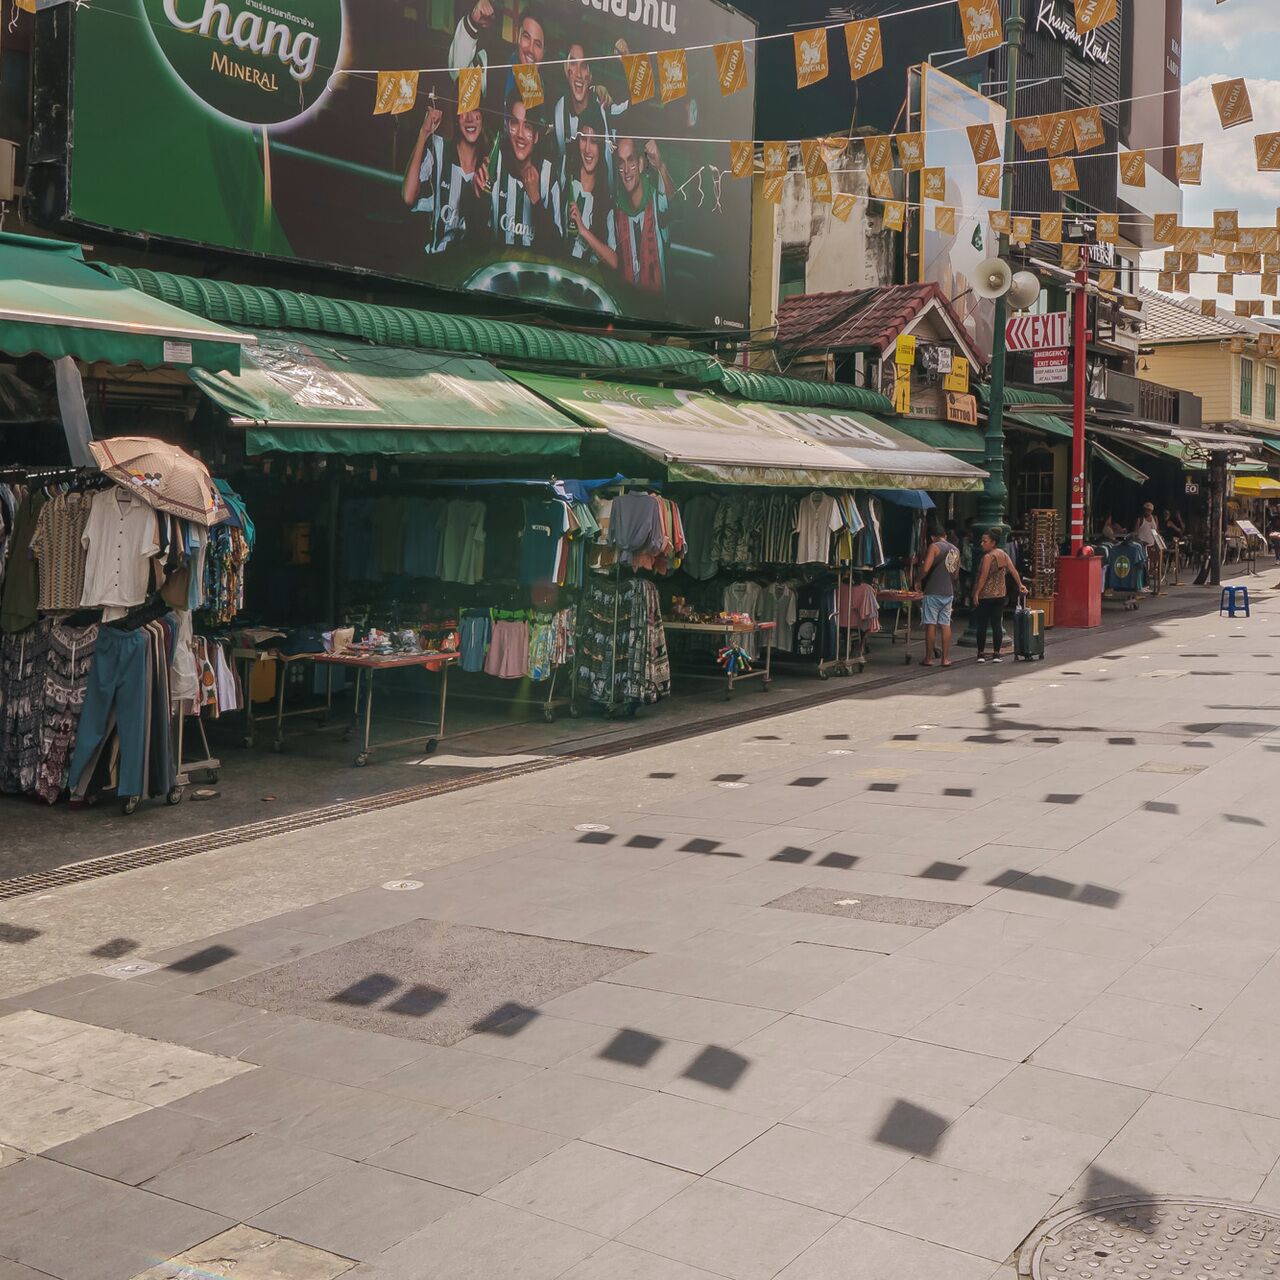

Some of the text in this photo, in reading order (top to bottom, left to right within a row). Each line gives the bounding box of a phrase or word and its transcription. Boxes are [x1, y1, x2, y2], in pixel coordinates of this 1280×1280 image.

[854, 26, 876, 71] SINGHA
[966, 29, 1000, 43] SINGHA
[1083, 28, 1110, 66] Road
[210, 52, 279, 92] MINERAL
[633, 60, 648, 96] SINGHA
[724, 48, 740, 89] SINGHA
[379, 78, 396, 109] SINGHA
[461, 73, 479, 108] SINGHA
[1223, 84, 1242, 119] SINGHA
[976, 128, 992, 159] SINGHA
[1049, 118, 1066, 150] SINGHA
[733, 146, 751, 174] SINGHA
[873, 141, 886, 169] SINGHA
[1124, 155, 1143, 183] SINGHA
[980, 168, 998, 195] SINGHA
[1032, 313, 1067, 347] EXIT
[1034, 350, 1067, 358] EMERGENCY
[949, 408, 970, 421] TATTOO
